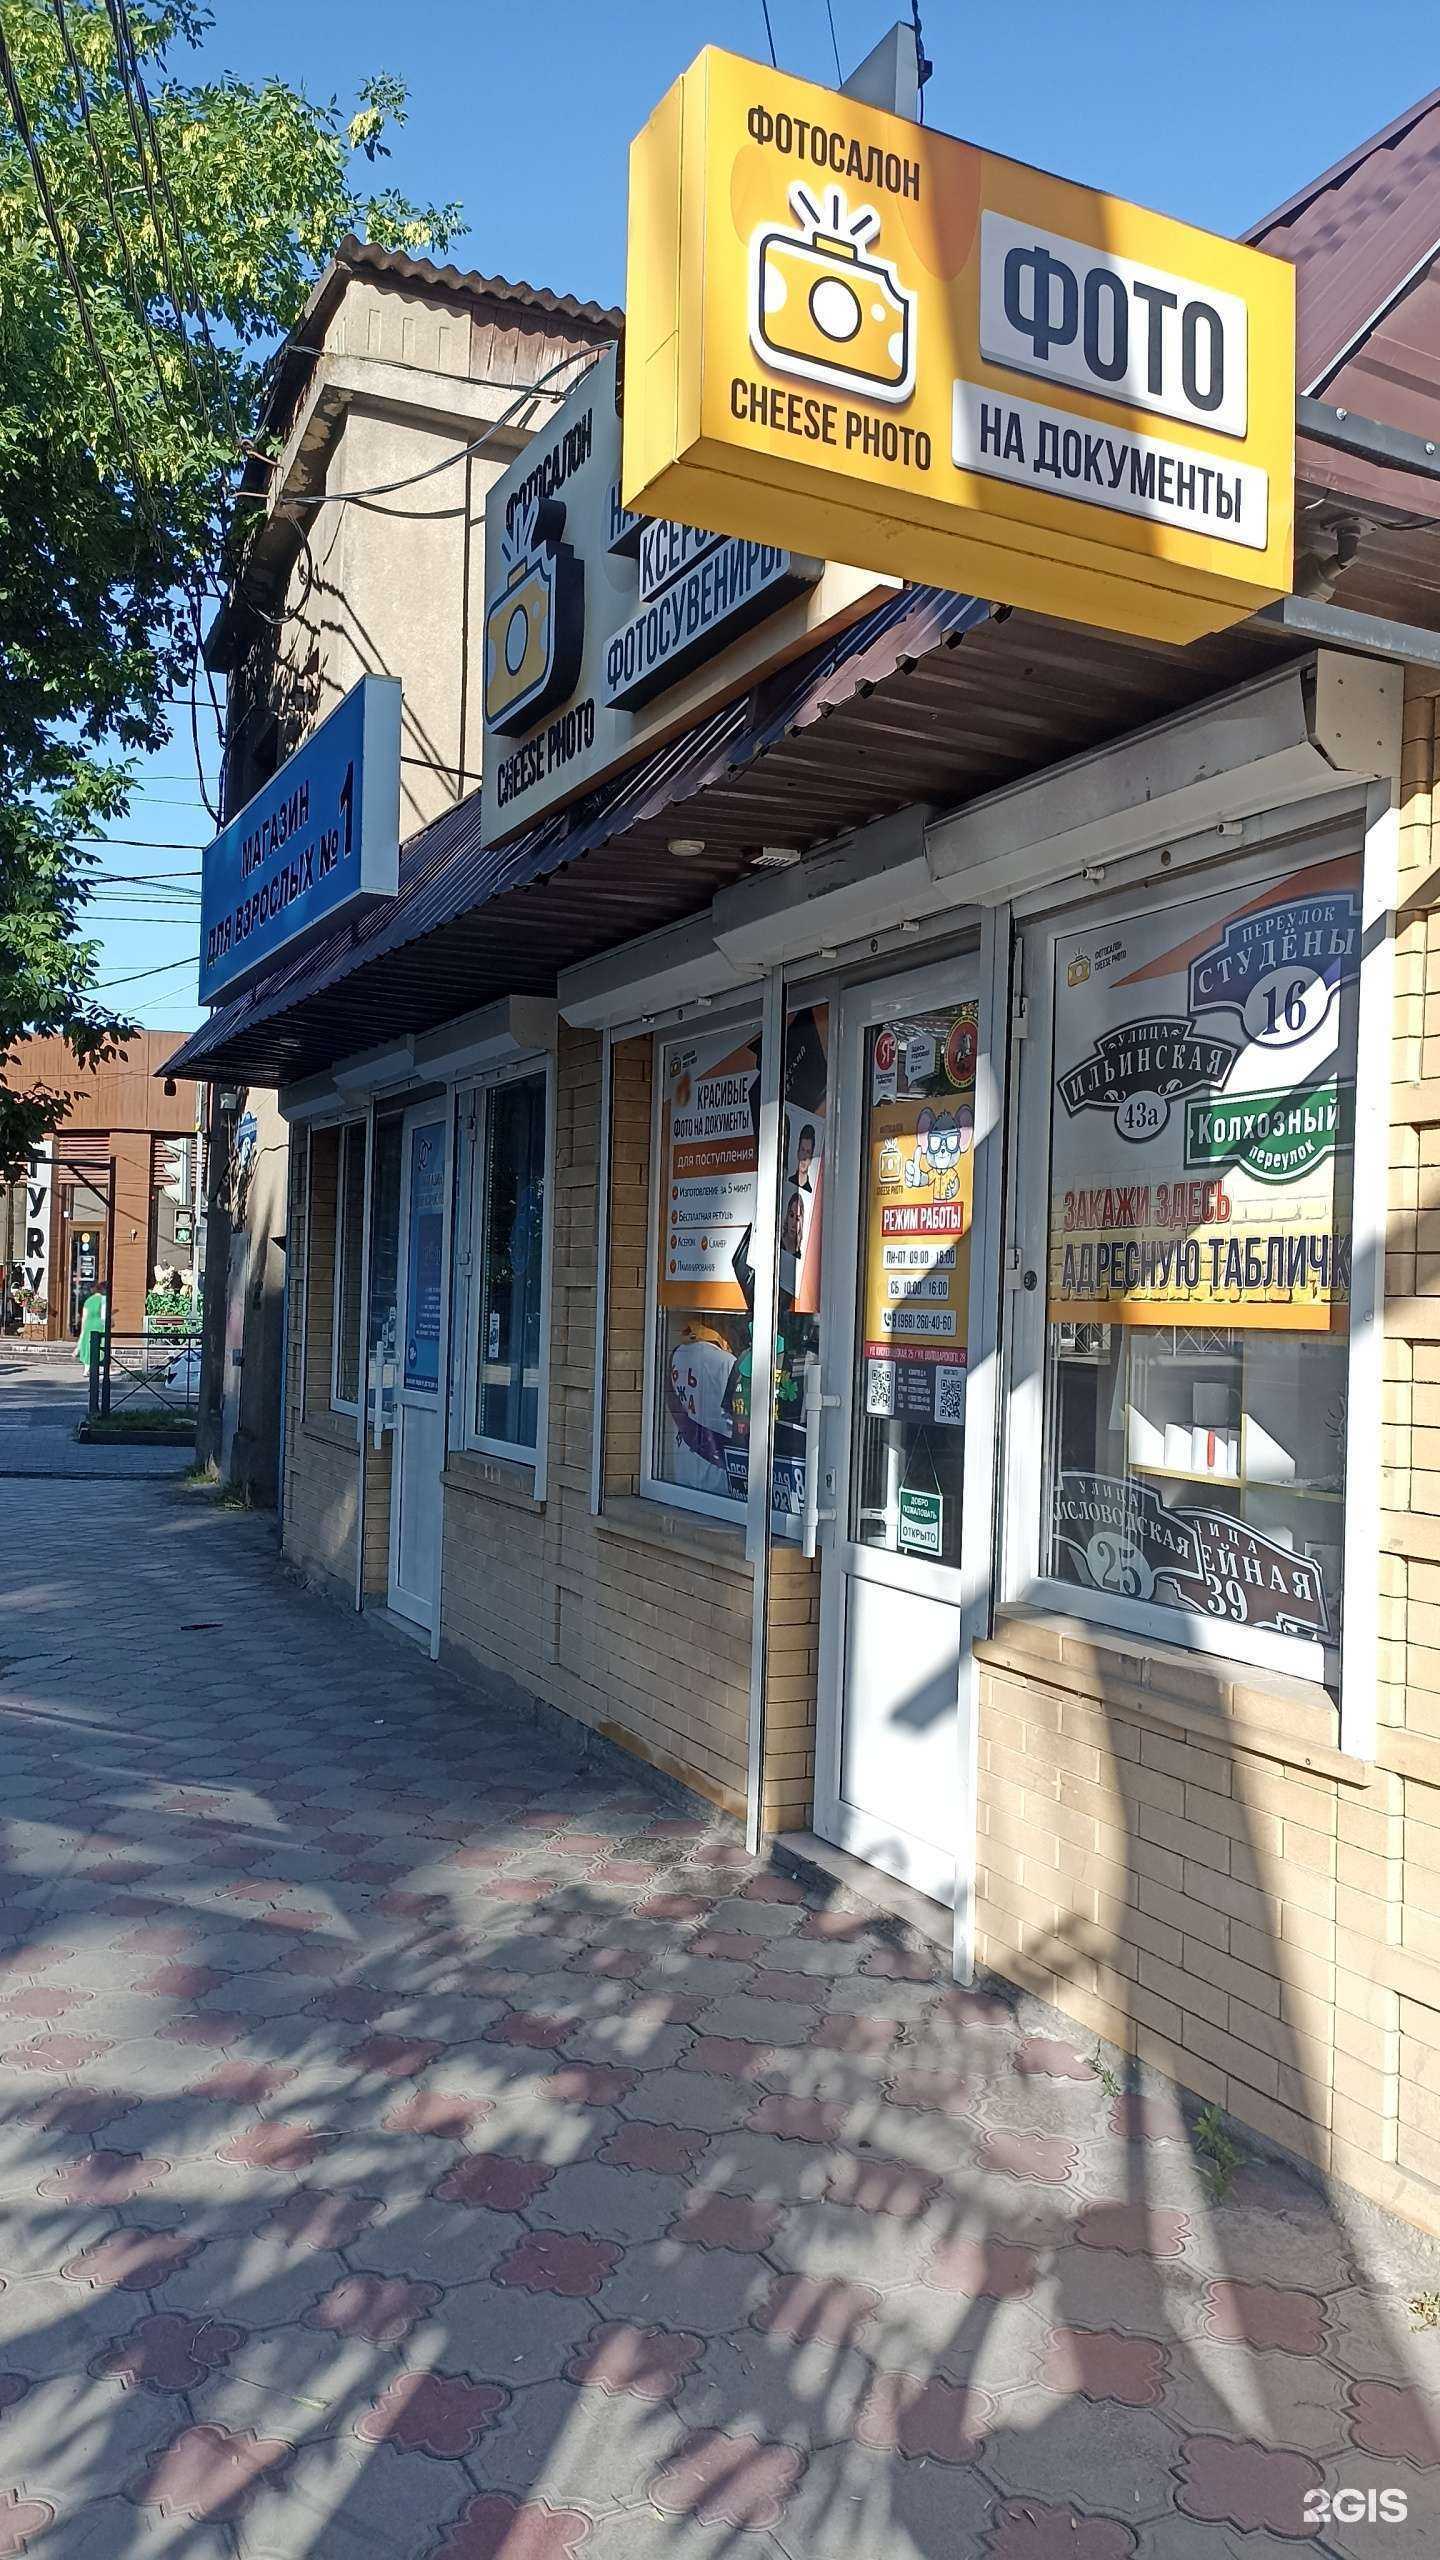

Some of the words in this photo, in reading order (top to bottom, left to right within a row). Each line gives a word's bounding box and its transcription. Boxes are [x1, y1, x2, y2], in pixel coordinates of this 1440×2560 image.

[747, 105, 921, 202] ФОТОСАЛОН
[1004, 245, 1225, 412] ФОТО
[730, 377, 836, 447] CHEESE
[846, 411, 931, 471] PHOTO
[980, 403, 1025, 464] НА
[1033, 422, 1241, 523] ДОКУМЕНТЫ
[498, 732, 545, 808] CHEESE
[547, 698, 595, 774] PHOTO
[240, 780, 309, 881] МАГАЗИН
[207, 914, 232, 969] ДЛЯ
[235, 844, 314, 945] ВЗРОСЛЫХ
[1242, 906, 1336, 942] ПЕРЕУЛОК
[1262, 980, 1307, 1035] 16
[1118, 1026, 1168, 1047] УЛИЦА
[697, 1077, 748, 1110] КРАСИВЫЕ
[1070, 1044, 1223, 1101] ИЛЬИНСКАЯ
[674, 1118, 692, 1138] ФОТО
[694, 1117, 702, 1136] НА
[704, 1110, 750, 1135] ДОКУМЕНТЫ
[1124, 1102, 1159, 1129] 43а
[1249, 1139, 1316, 1171] переулок
[728, 1182, 733, 1194] 5
[1063, 1185, 1150, 1232] ЗАКАЖИ
[1156, 1179, 1232, 1231] ЗДЕСЬ
[883, 1206, 918, 1231] РЕЖИМ
[920, 1204, 961, 1229] РАБОТЫ
[1062, 1238, 1200, 1293] АДРЕСНУЮ
[1208, 1234, 1351, 1288] ТАБЛИЧК
[903, 1505, 937, 1520] ПОЖАЛОВАТЬ
[911, 1496, 928, 1507] ДОБРО
[1079, 1480, 1139, 1507] УЛИЦА
[903, 1526, 936, 1543] ОТКРЫТО
[1097, 1541, 1142, 1596] 25
[1206, 1573, 1248, 1622] 39
